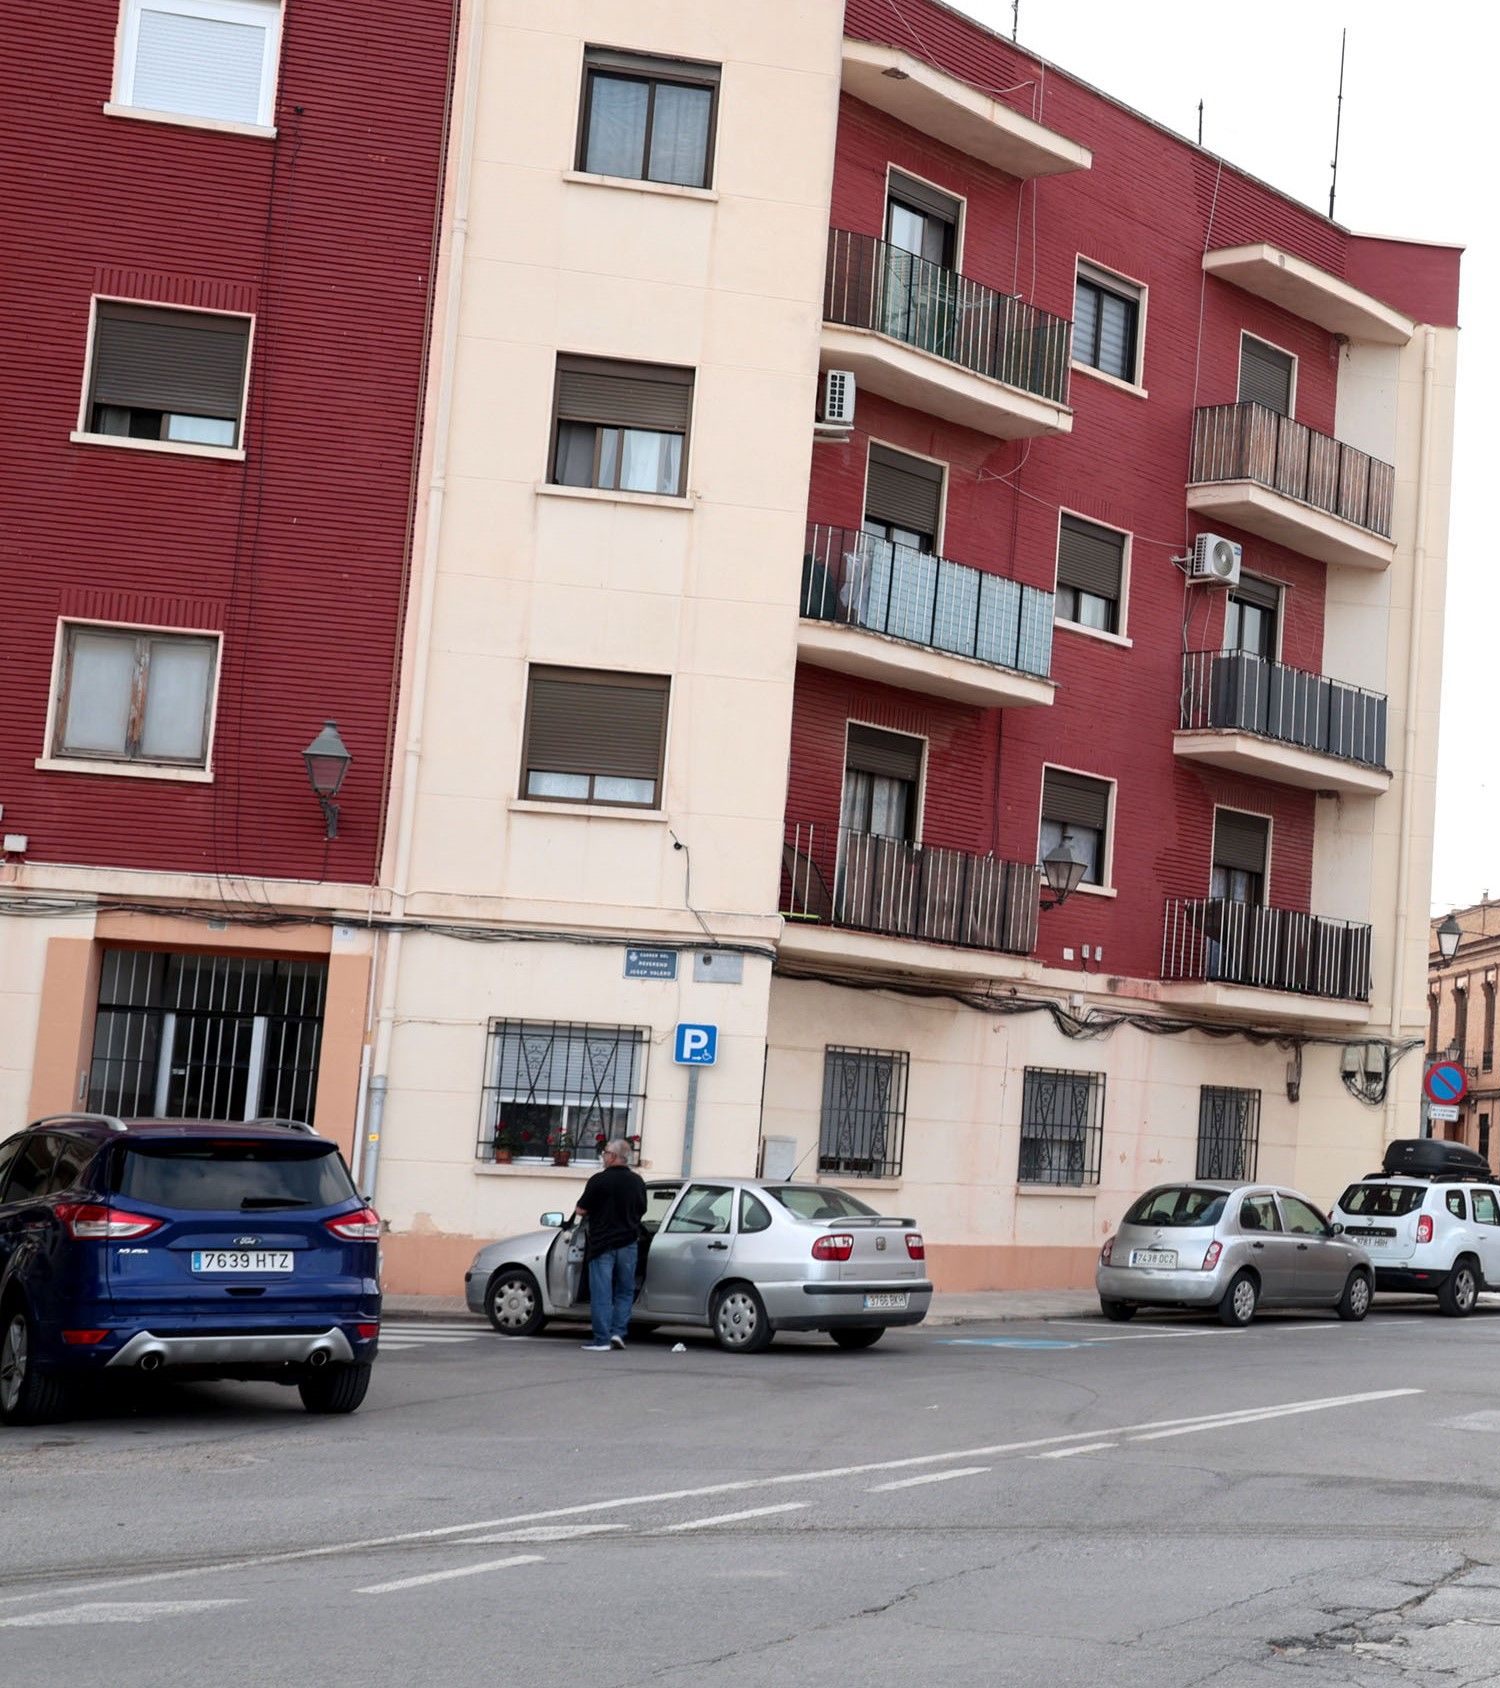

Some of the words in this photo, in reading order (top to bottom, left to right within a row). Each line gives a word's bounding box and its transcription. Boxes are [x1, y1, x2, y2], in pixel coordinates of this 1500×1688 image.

[683, 1029, 709, 1058] P
[205, 1253, 250, 1269] 7639
[256, 1254, 289, 1268] HTZ
